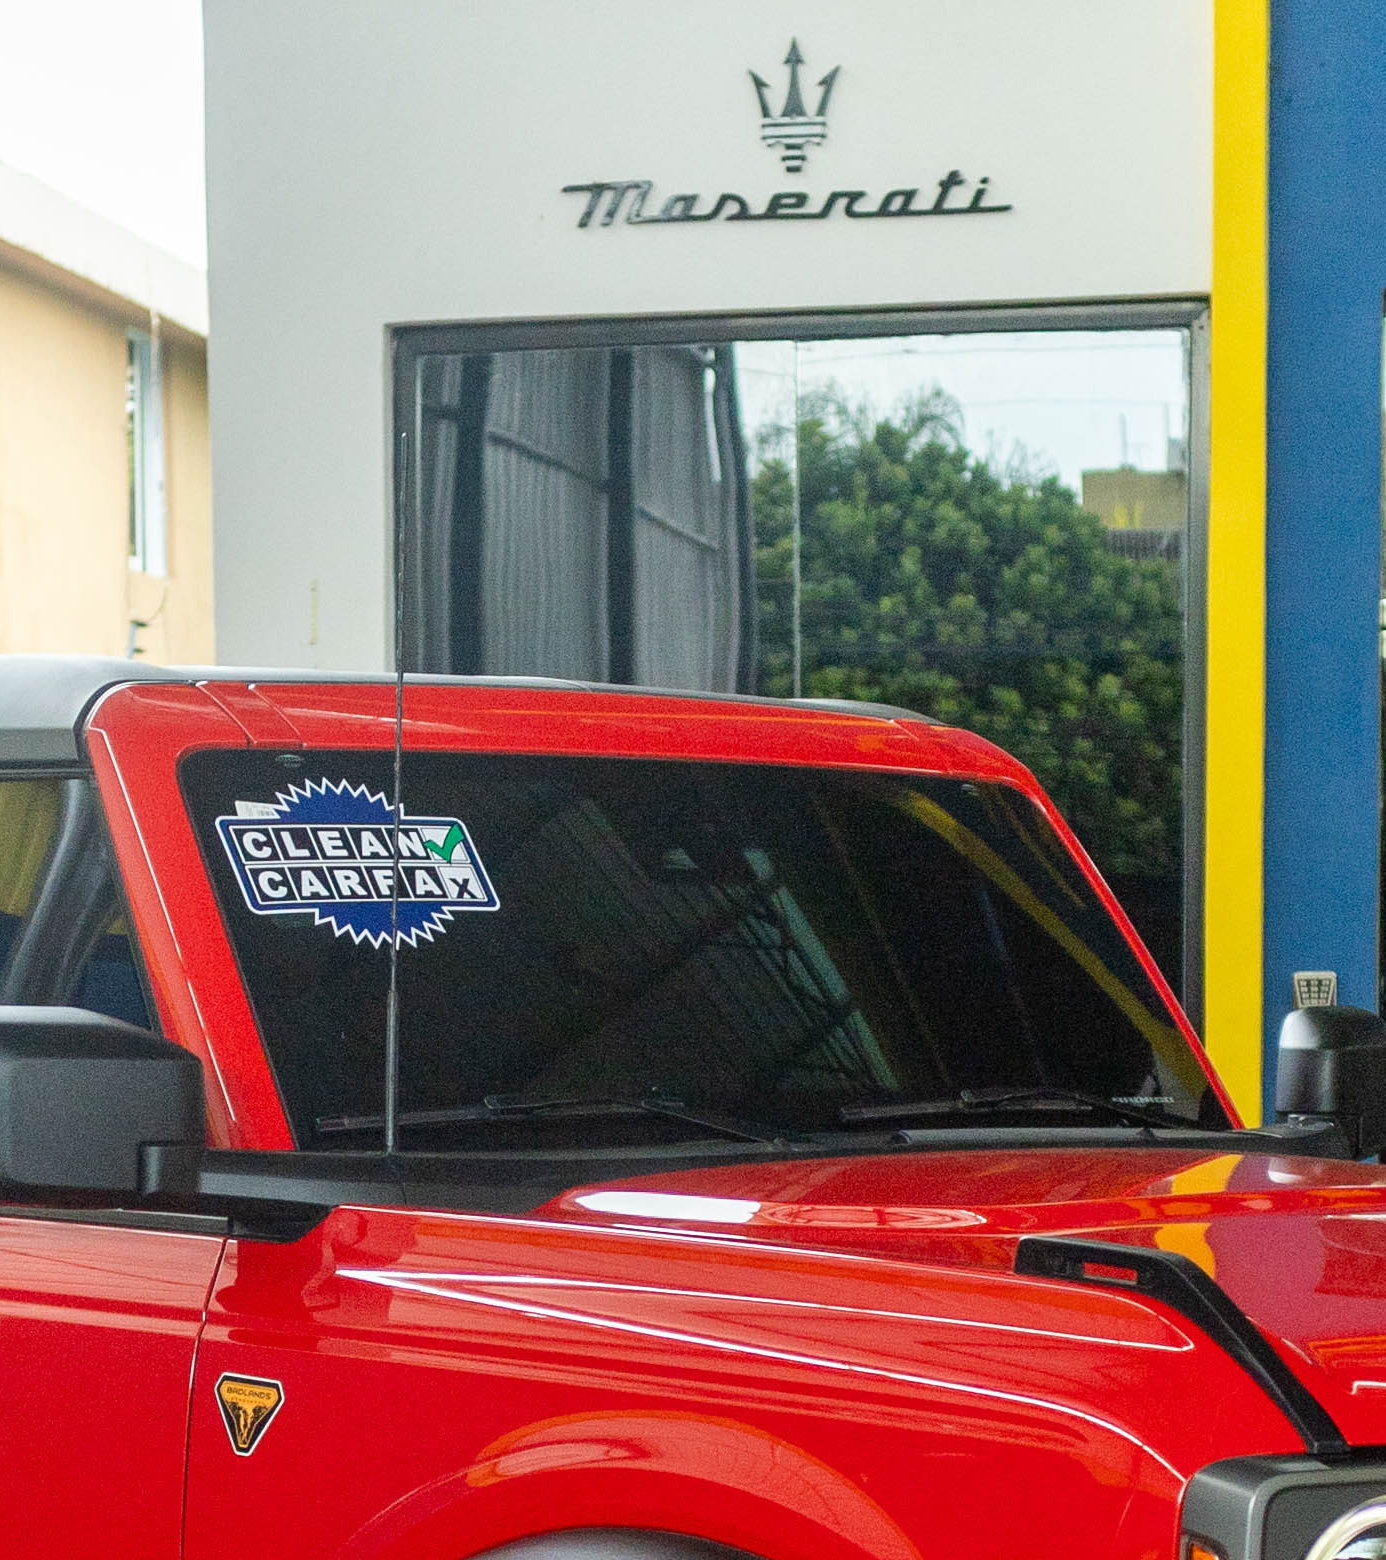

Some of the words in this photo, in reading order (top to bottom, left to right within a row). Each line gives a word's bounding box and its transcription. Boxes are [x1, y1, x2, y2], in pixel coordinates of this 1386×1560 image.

[562, 169, 1013, 229] Maserati
[241, 829, 428, 859] CLEAN
[258, 868, 477, 899] CARFAX
[226, 1386, 272, 1401] BADLANDS
